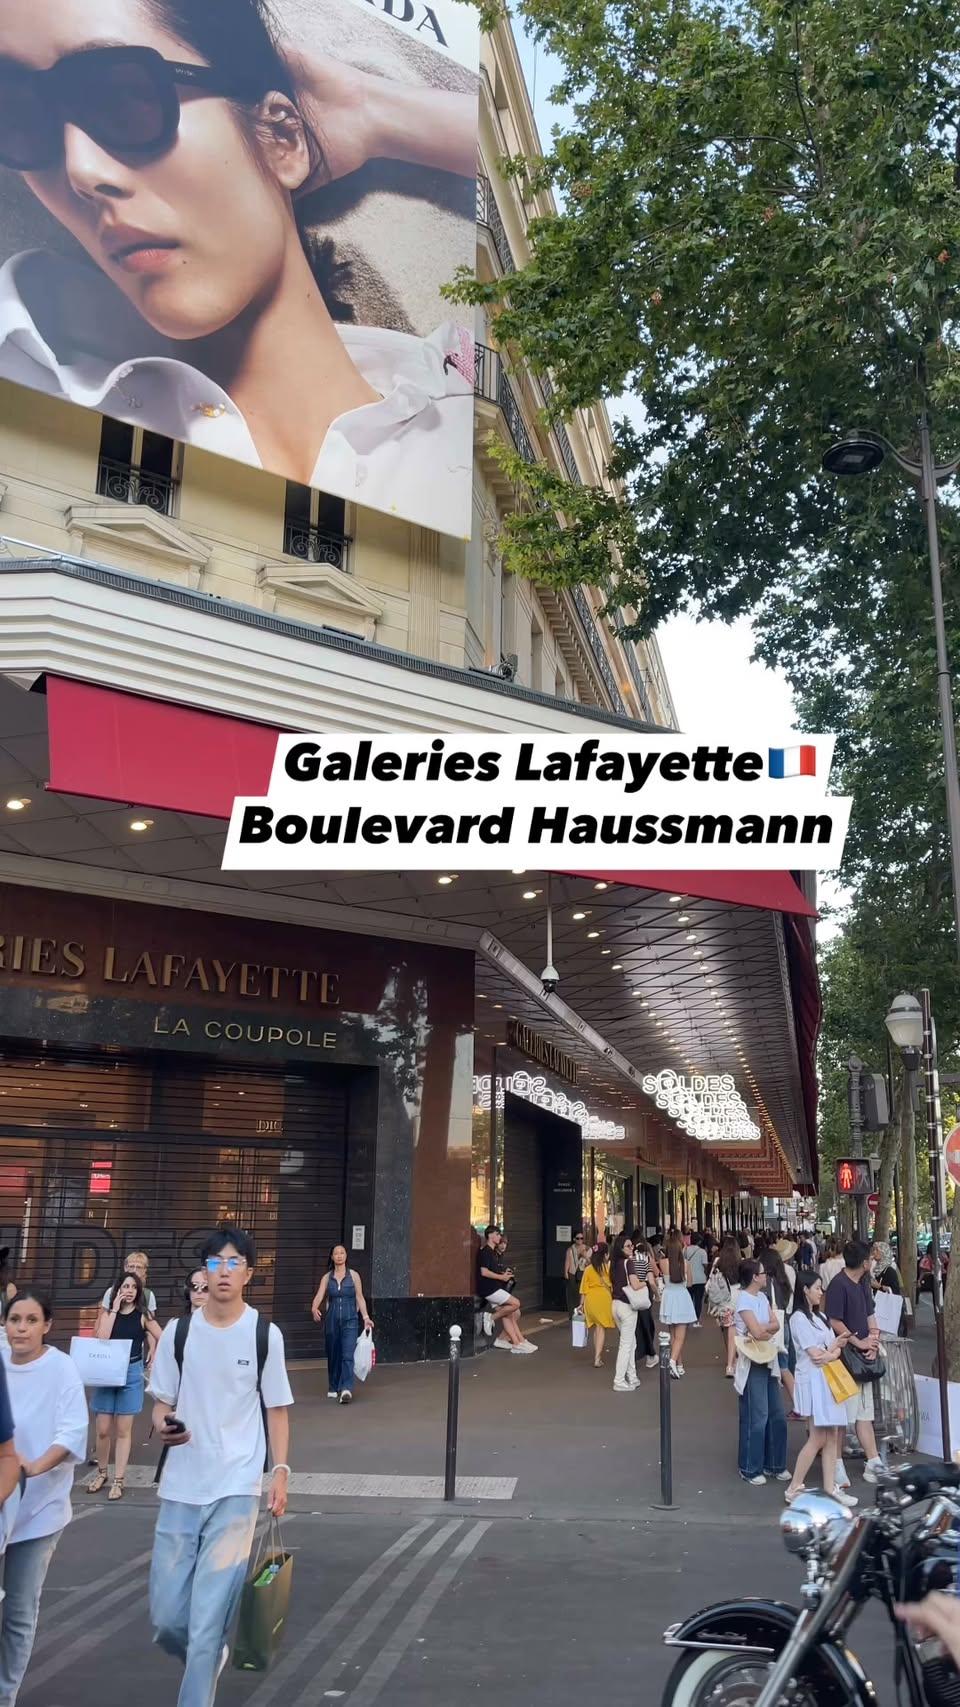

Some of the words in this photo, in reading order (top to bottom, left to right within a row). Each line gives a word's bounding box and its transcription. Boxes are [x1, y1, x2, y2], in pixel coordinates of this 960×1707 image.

[366, 0, 449, 47] DA
[104, 947, 340, 1004] LAFAYETTE
[154, 1016, 191, 1036] LA
[205, 1021, 337, 1049] COUPOLE
[642, 1069, 736, 1094] SOLDES
